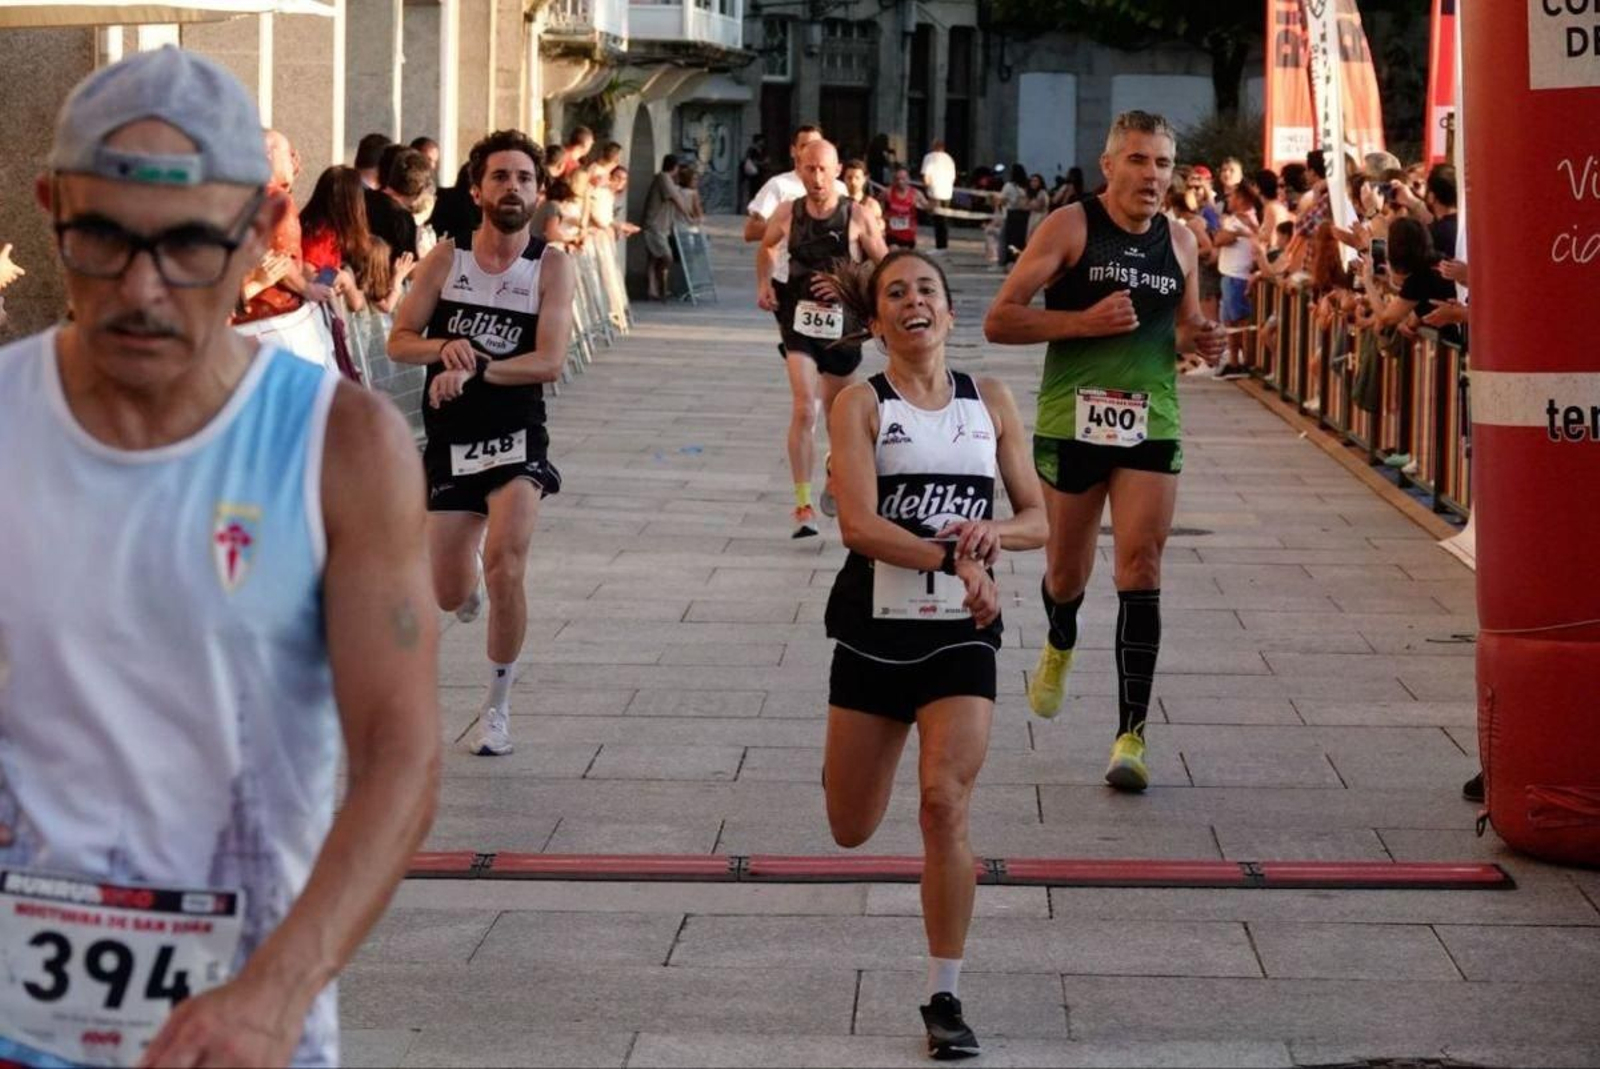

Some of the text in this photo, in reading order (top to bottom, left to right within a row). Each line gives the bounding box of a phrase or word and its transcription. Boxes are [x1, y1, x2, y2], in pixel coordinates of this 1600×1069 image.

[1542, 0, 1600, 17] CO
[1089, 260, 1129, 283] máis
[1140, 272, 1177, 295] auga
[447, 308, 523, 343] delikia
[802, 311, 835, 329] 364
[1088, 404, 1136, 431] 400
[464, 434, 515, 460] 248
[881, 482, 988, 521] delikia
[23, 930, 190, 1010] 394
